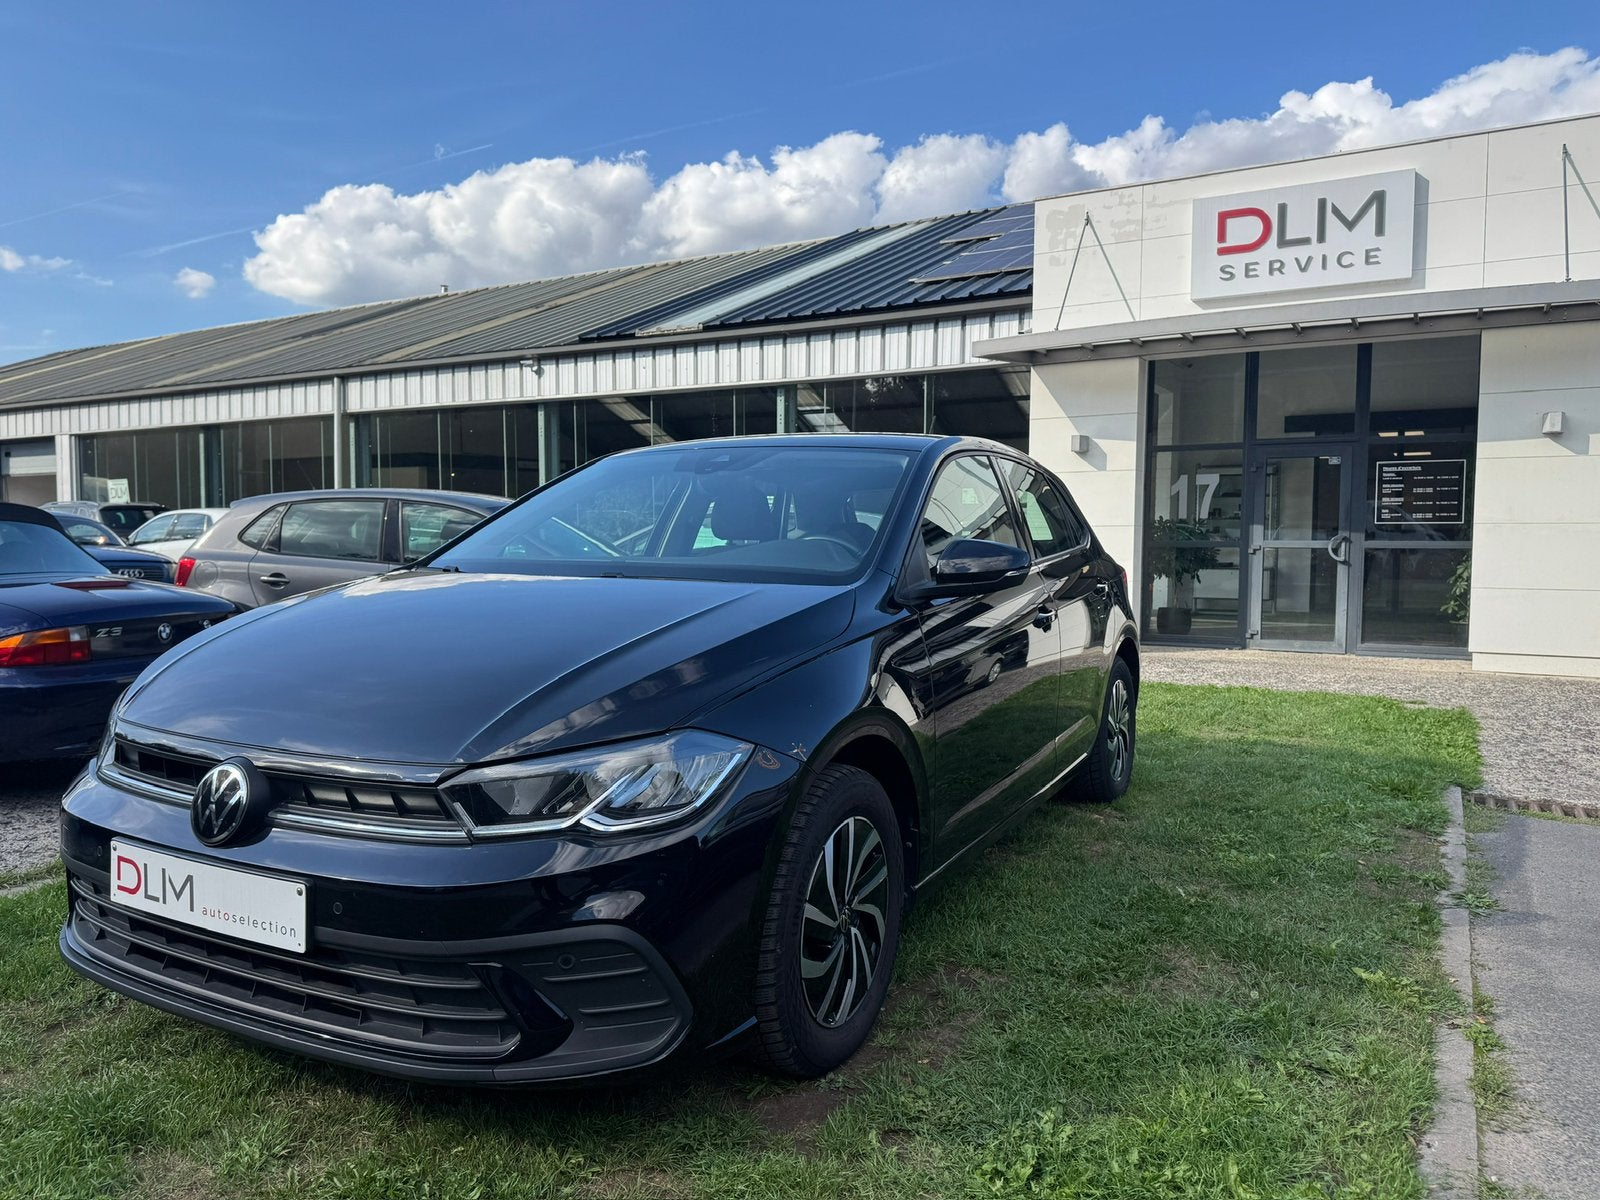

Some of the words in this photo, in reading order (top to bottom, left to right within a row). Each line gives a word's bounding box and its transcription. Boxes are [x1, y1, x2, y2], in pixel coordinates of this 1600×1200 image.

[1217, 189, 1387, 256] DLM
[1219, 247, 1382, 281] SERVICE
[1170, 473, 1220, 519] 17
[96, 626, 123, 638] Z3
[117, 855, 195, 912] DLM
[201, 906, 297, 938] autoselection
